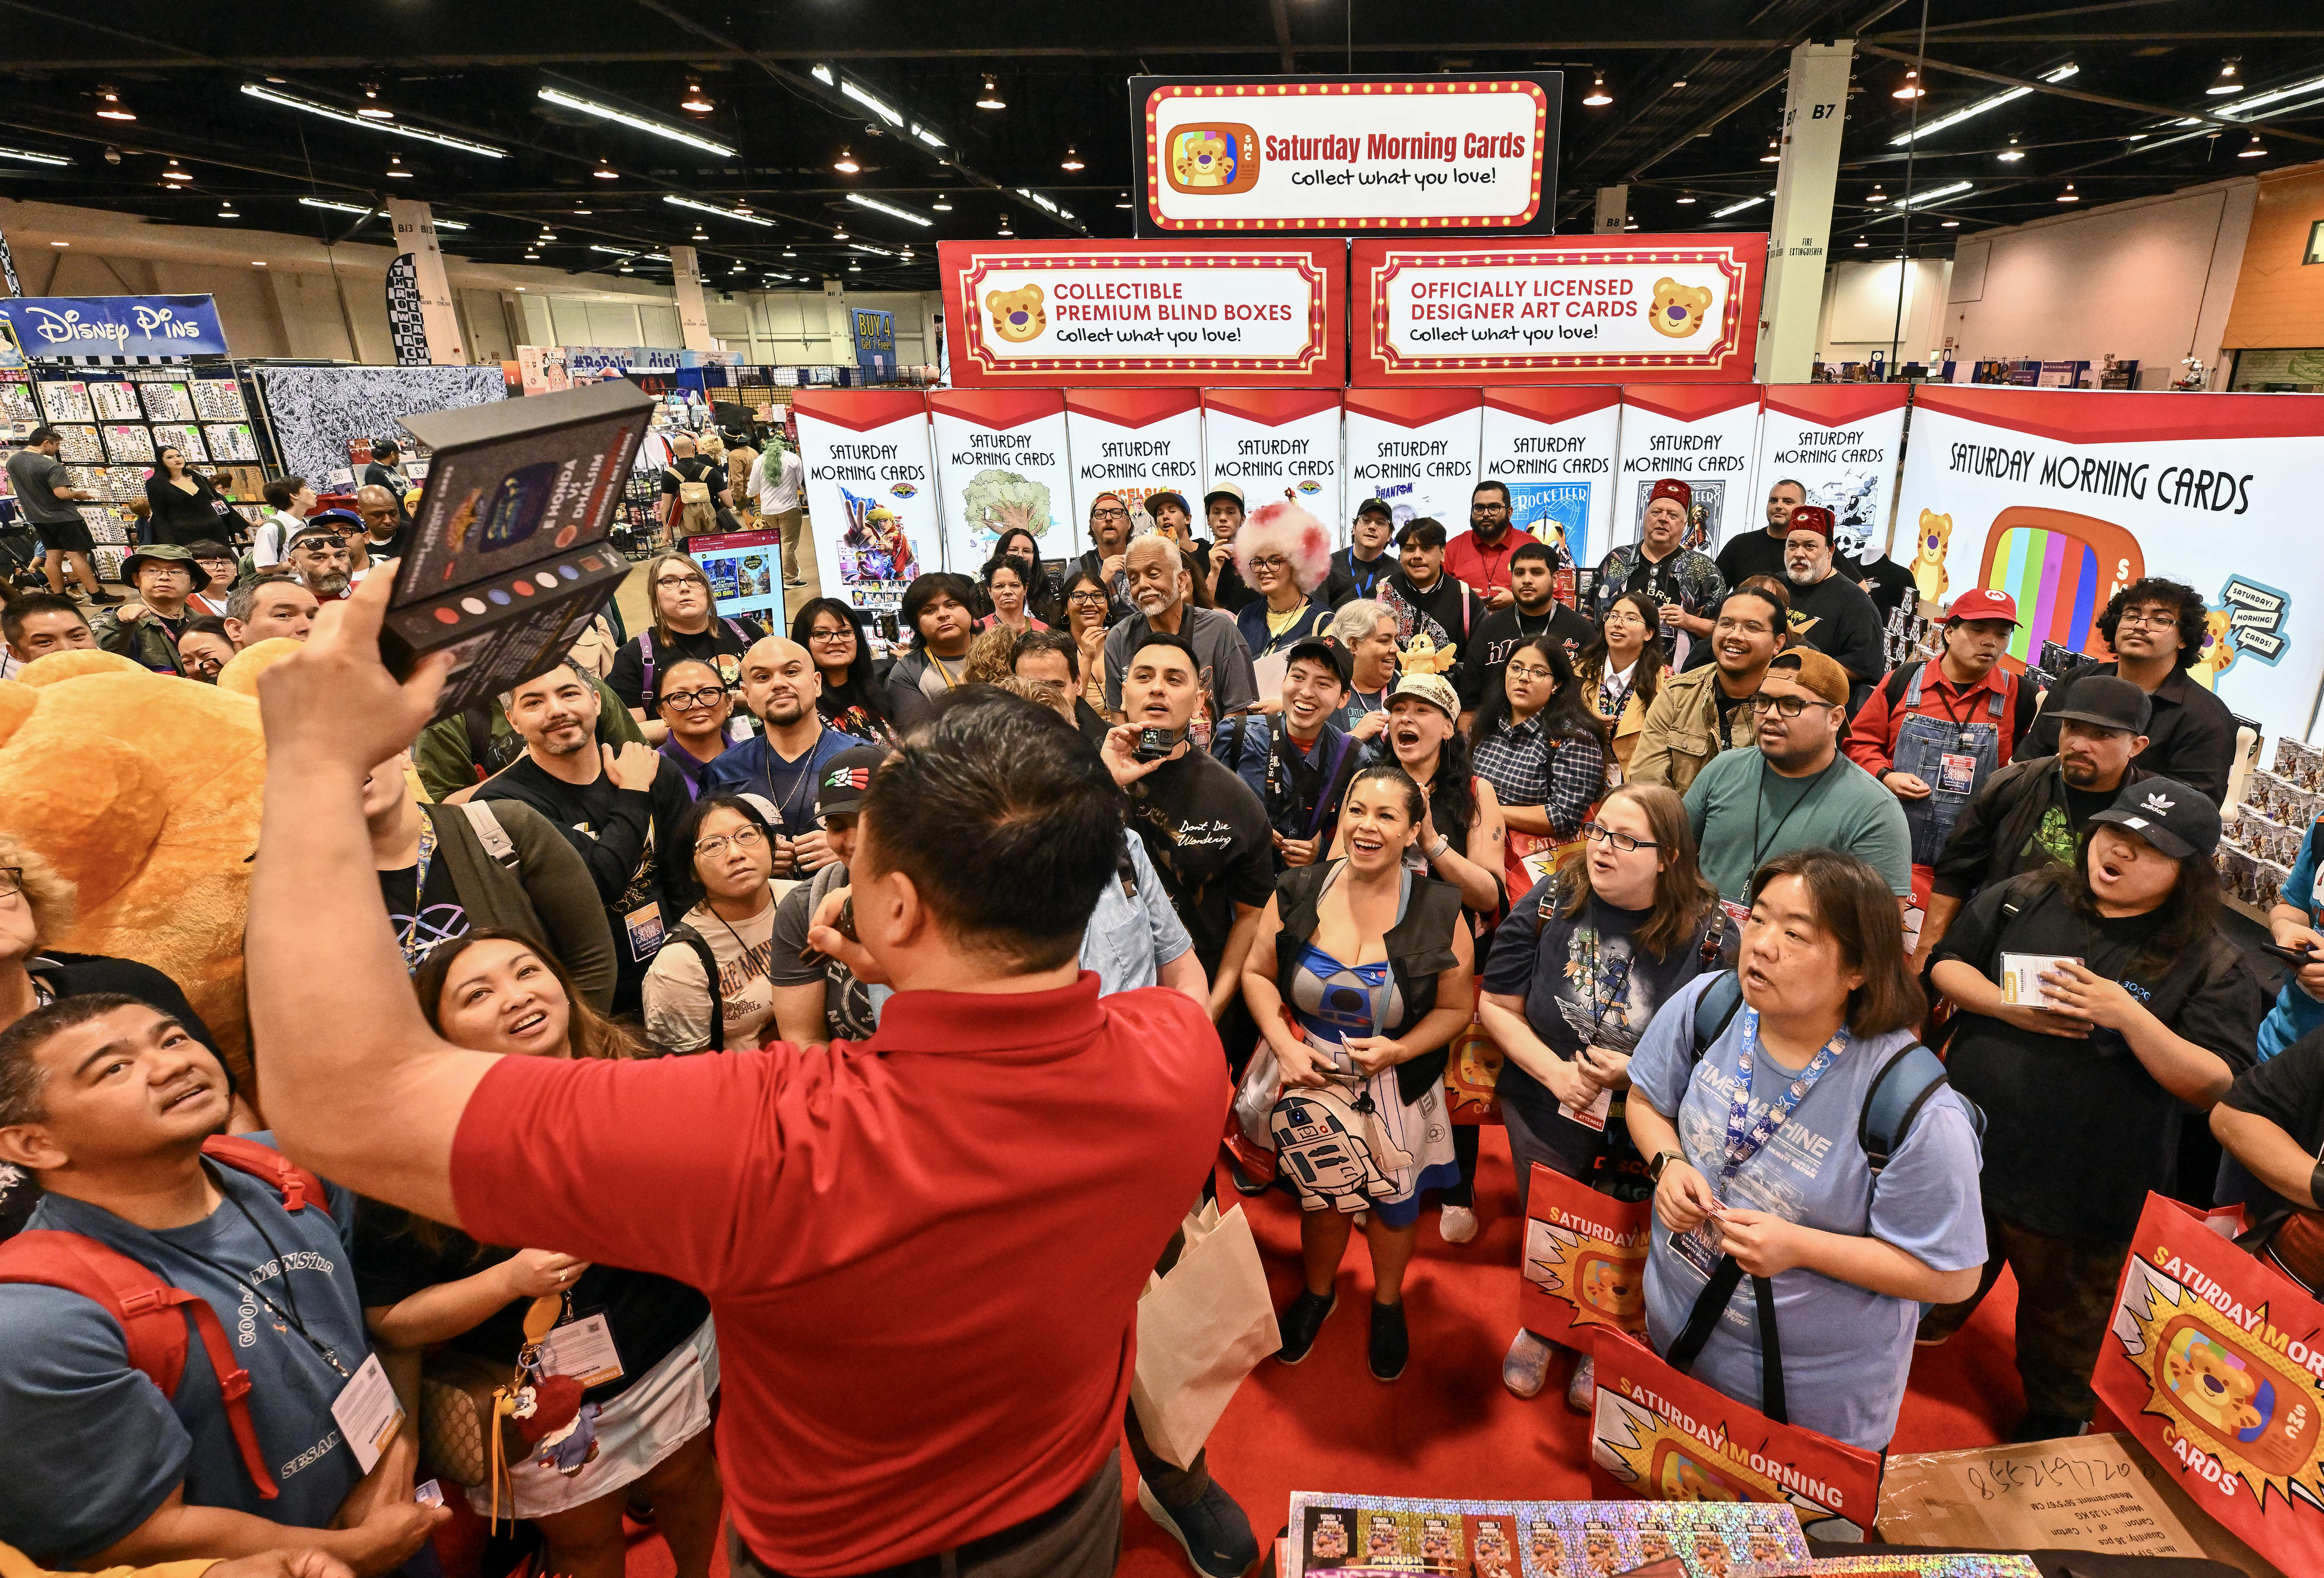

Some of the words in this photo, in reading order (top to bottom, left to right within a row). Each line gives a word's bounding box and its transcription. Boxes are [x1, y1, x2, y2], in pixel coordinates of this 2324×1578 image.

[1787, 108, 1796, 126] B7
[1812, 104, 1835, 120] B7
[1265, 134, 1361, 163] Saturday
[1367, 131, 1456, 163] Morning
[1464, 131, 1525, 159] Cards
[1292, 169, 1355, 185] Collect
[1358, 168, 1409, 185] what
[1415, 171, 1447, 191] you
[1452, 167, 1496, 184] love!
[399, 224, 413, 232] B13
[421, 225, 432, 234] B13
[1606, 218, 1619, 227] B8
[1802, 238, 1812, 248] FIRE
[1789, 247, 1823, 257] EXTINGUISHER
[1054, 283, 1182, 300] COLLECTIBLE
[1411, 281, 1527, 299] OFFICIALLY
[1534, 279, 1633, 296] LICENSED
[1056, 305, 1152, 321] PREMIUM
[1159, 305, 1217, 321] BLIND
[1224, 304, 1292, 321] BOXES
[1412, 302, 1515, 320] DESIGNER
[1520, 302, 1559, 318] ART
[1568, 300, 1637, 317] CARDS
[406, 279, 425, 357] THERAPY
[858, 313, 880, 337] BUY
[884, 316, 891, 338] 4
[1056, 329, 1113, 342] Collect
[1116, 329, 1164, 342] what
[1168, 331, 1197, 347] you
[1203, 327, 1241, 342] love!
[1410, 328, 1468, 342] Collect
[1472, 326, 1519, 341] what
[1524, 330, 1553, 345] you
[1558, 325, 1598, 340] love!
[861, 338, 871, 350] Get
[872, 339, 876, 350] 1
[877, 339, 891, 351] Free!
[970, 435, 1031, 448] SATURDAY
[1514, 437, 1586, 452] SATURDAY
[1650, 435, 1723, 451] SATURDAY
[1798, 432, 1864, 446] SATURDAY
[830, 445, 897, 460] SATURDAY
[1102, 441, 1171, 457] SATURDAY
[1238, 439, 1310, 455] SATURDAY
[1378, 440, 1448, 457] SATURDAY
[952, 452, 1010, 465] MORNING
[1016, 452, 1055, 466] CARDS
[1623, 457, 1692, 472] MORNING
[1699, 456, 1745, 471] CARDS
[1774, 449, 1835, 464] MORNING
[1842, 449, 1884, 462] CARDS
[812, 466, 875, 480] MORNING
[881, 466, 925, 480] CARDS
[1081, 463, 1146, 478] MORNING
[1152, 461, 1196, 476] CARDS
[1215, 461, 1282, 476] MORNING
[1288, 460, 1334, 476] CARDS
[1354, 462, 1421, 479] MORNING
[1427, 461, 1471, 476] CARDS
[1489, 459, 1556, 475] MORNING
[1563, 458, 1609, 473] CARDS
[1950, 442, 2035, 482] SATURDAY
[2040, 455, 2150, 500] MORNING
[2158, 467, 2253, 514] CARDS
[550, 460, 578, 517] HONDA
[1375, 483, 1413, 500] PHANTOM
[1519, 488, 1587, 512] ROCKETEER
[1989, 591, 2005, 600] M
[2233, 588, 2273, 607] SATURDAY!
[2237, 614, 2272, 623] MORNING!
[2246, 633, 2272, 648] CARDS!
[817, 713, 827, 723] LIKE
[1943, 773, 1968, 782] GALAXIES
[2140, 802, 2167, 816] adidas
[1213, 820, 1231, 831] Die
[1177, 831, 1231, 849] Wondering
[636, 928, 661, 944] GALAXIES
[637, 923, 655, 937] SEVEN
[733, 1001, 756, 1011] MIGHT
[738, 1004, 762, 1015] LITTLE
[1701, 1059, 1735, 1098] TIME
[1748, 1097, 1833, 1159] MAHINE
[1579, 1114, 1602, 1127] ATTENDEE
[1550, 1207, 1635, 1247] SATURDAY
[1681, 1240, 1696, 1254] BOOTH
[1683, 1234, 1711, 1259] CHRONICLES
[1687, 1227, 1719, 1256] ALAXIES
[2153, 1246, 2264, 1332] SATURDAY
[2286, 1404, 2308, 1439] SMC
[1620, 1376, 1724, 1451] SATURDAY
[1728, 1441, 1844, 1509] MORNING
[2162, 1425, 2239, 1496] CARDS
[2077, 1491, 2133, 1505] Measurement:
[2030, 1502, 2046, 1511] CM
[2089, 1509, 2110, 1519] 11.35
[2111, 1504, 2144, 1515] Weight:
[2075, 1512, 2088, 1520] KG
[2122, 1518, 2154, 1527] Carton:
[2050, 1526, 2079, 1536] Carton
[2127, 1532, 2165, 1544] Quantity:
[2098, 1537, 2115, 1545] pcs
[2116, 1537, 2127, 1545] 36
[2155, 1545, 2177, 1553] Item:
